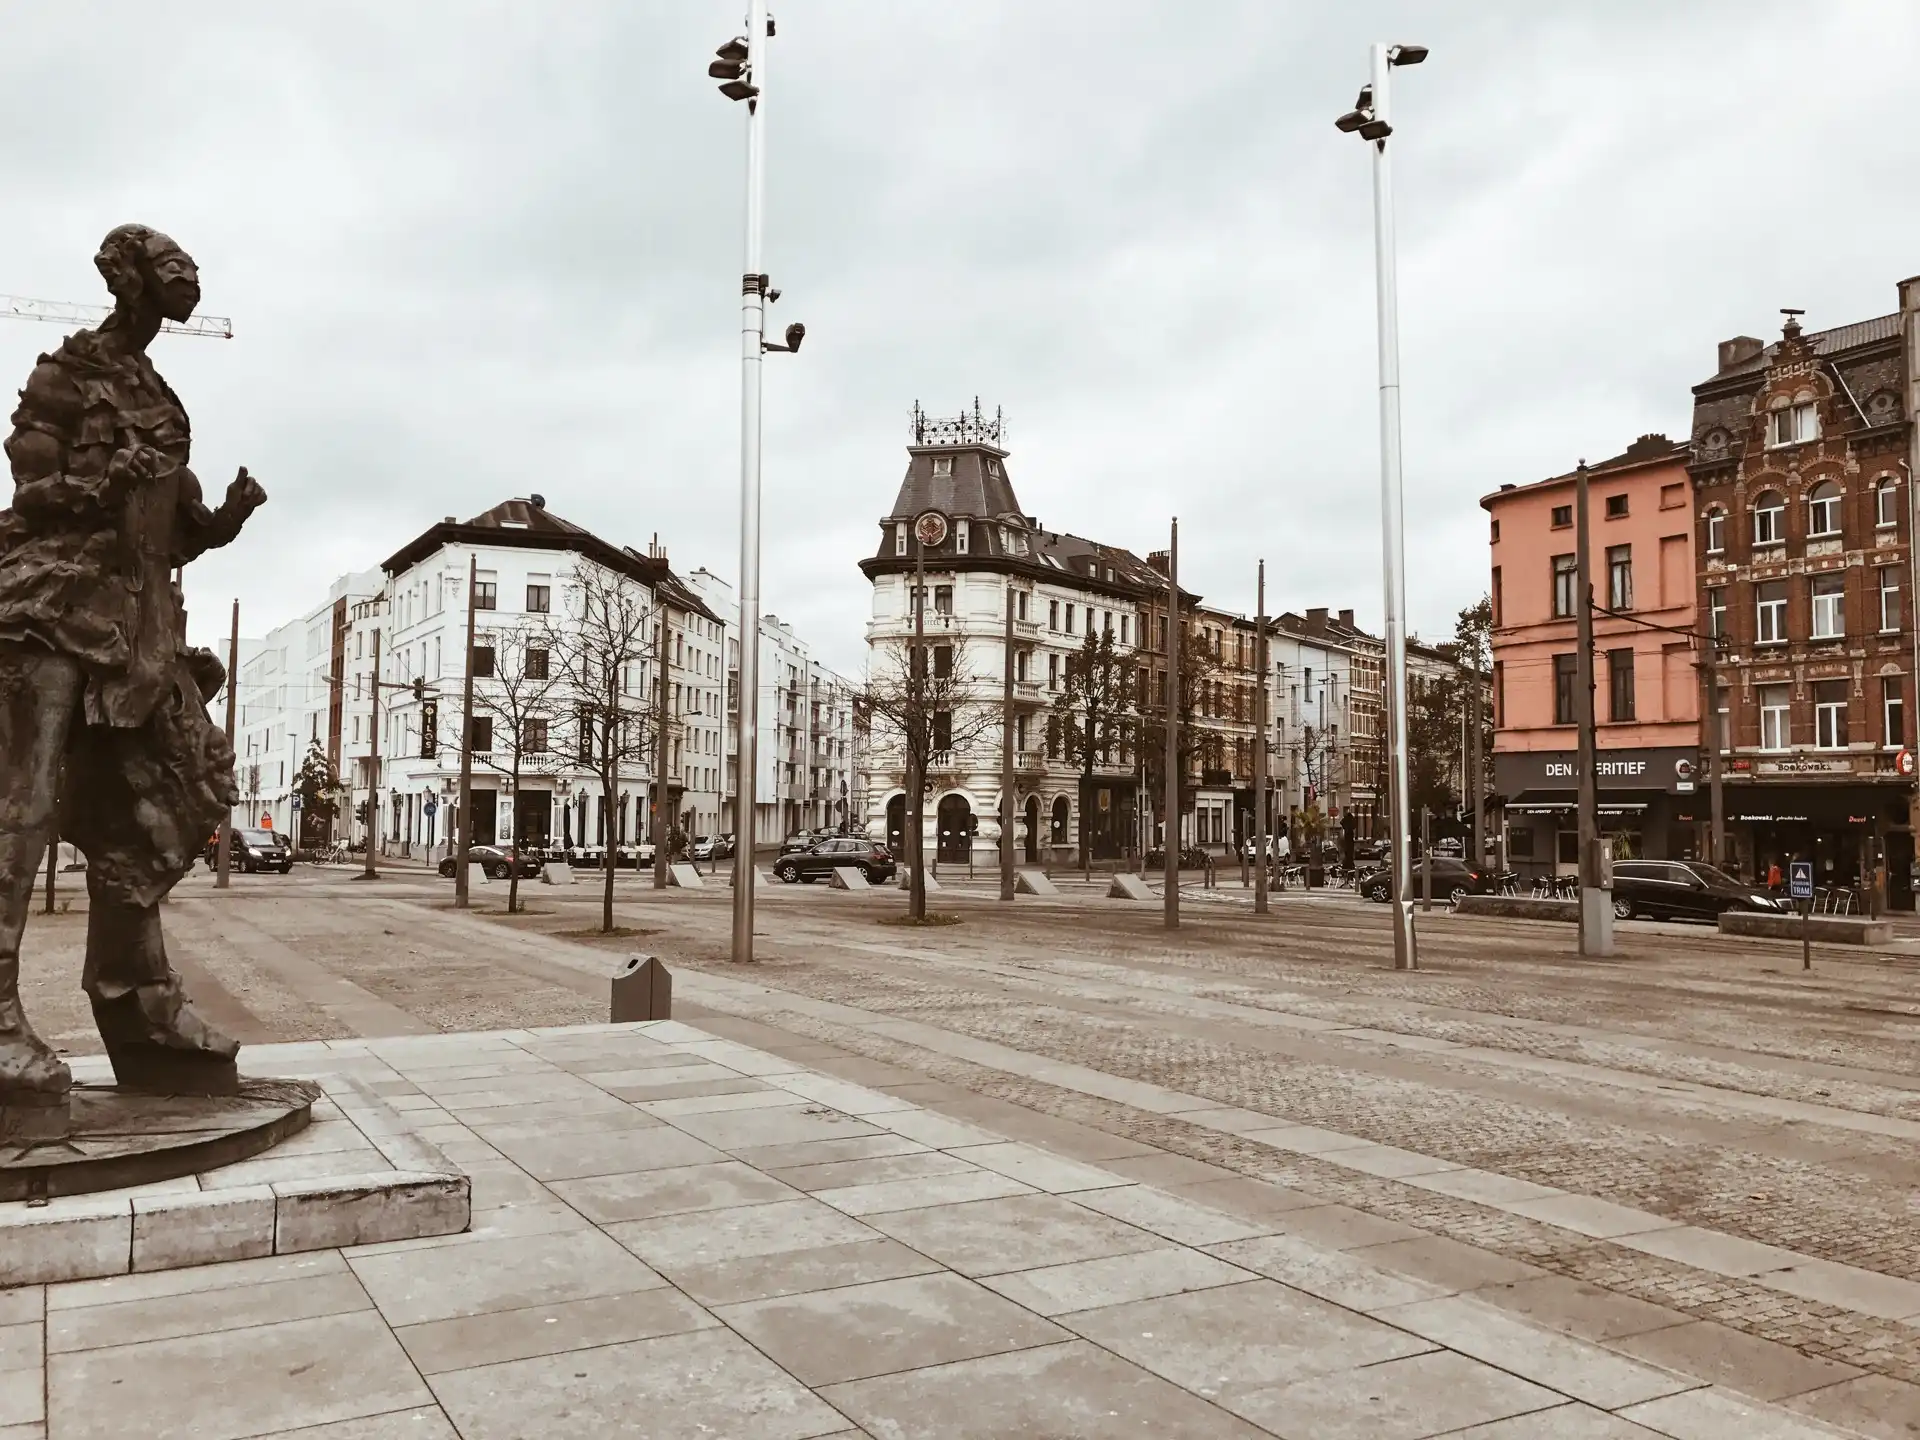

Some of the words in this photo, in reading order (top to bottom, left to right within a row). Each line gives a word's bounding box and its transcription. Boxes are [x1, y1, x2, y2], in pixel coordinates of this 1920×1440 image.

[1546, 763, 1572, 776] DEN
[1576, 762, 1646, 776] ERITIEF
[1793, 886, 1810, 895] TRAM
